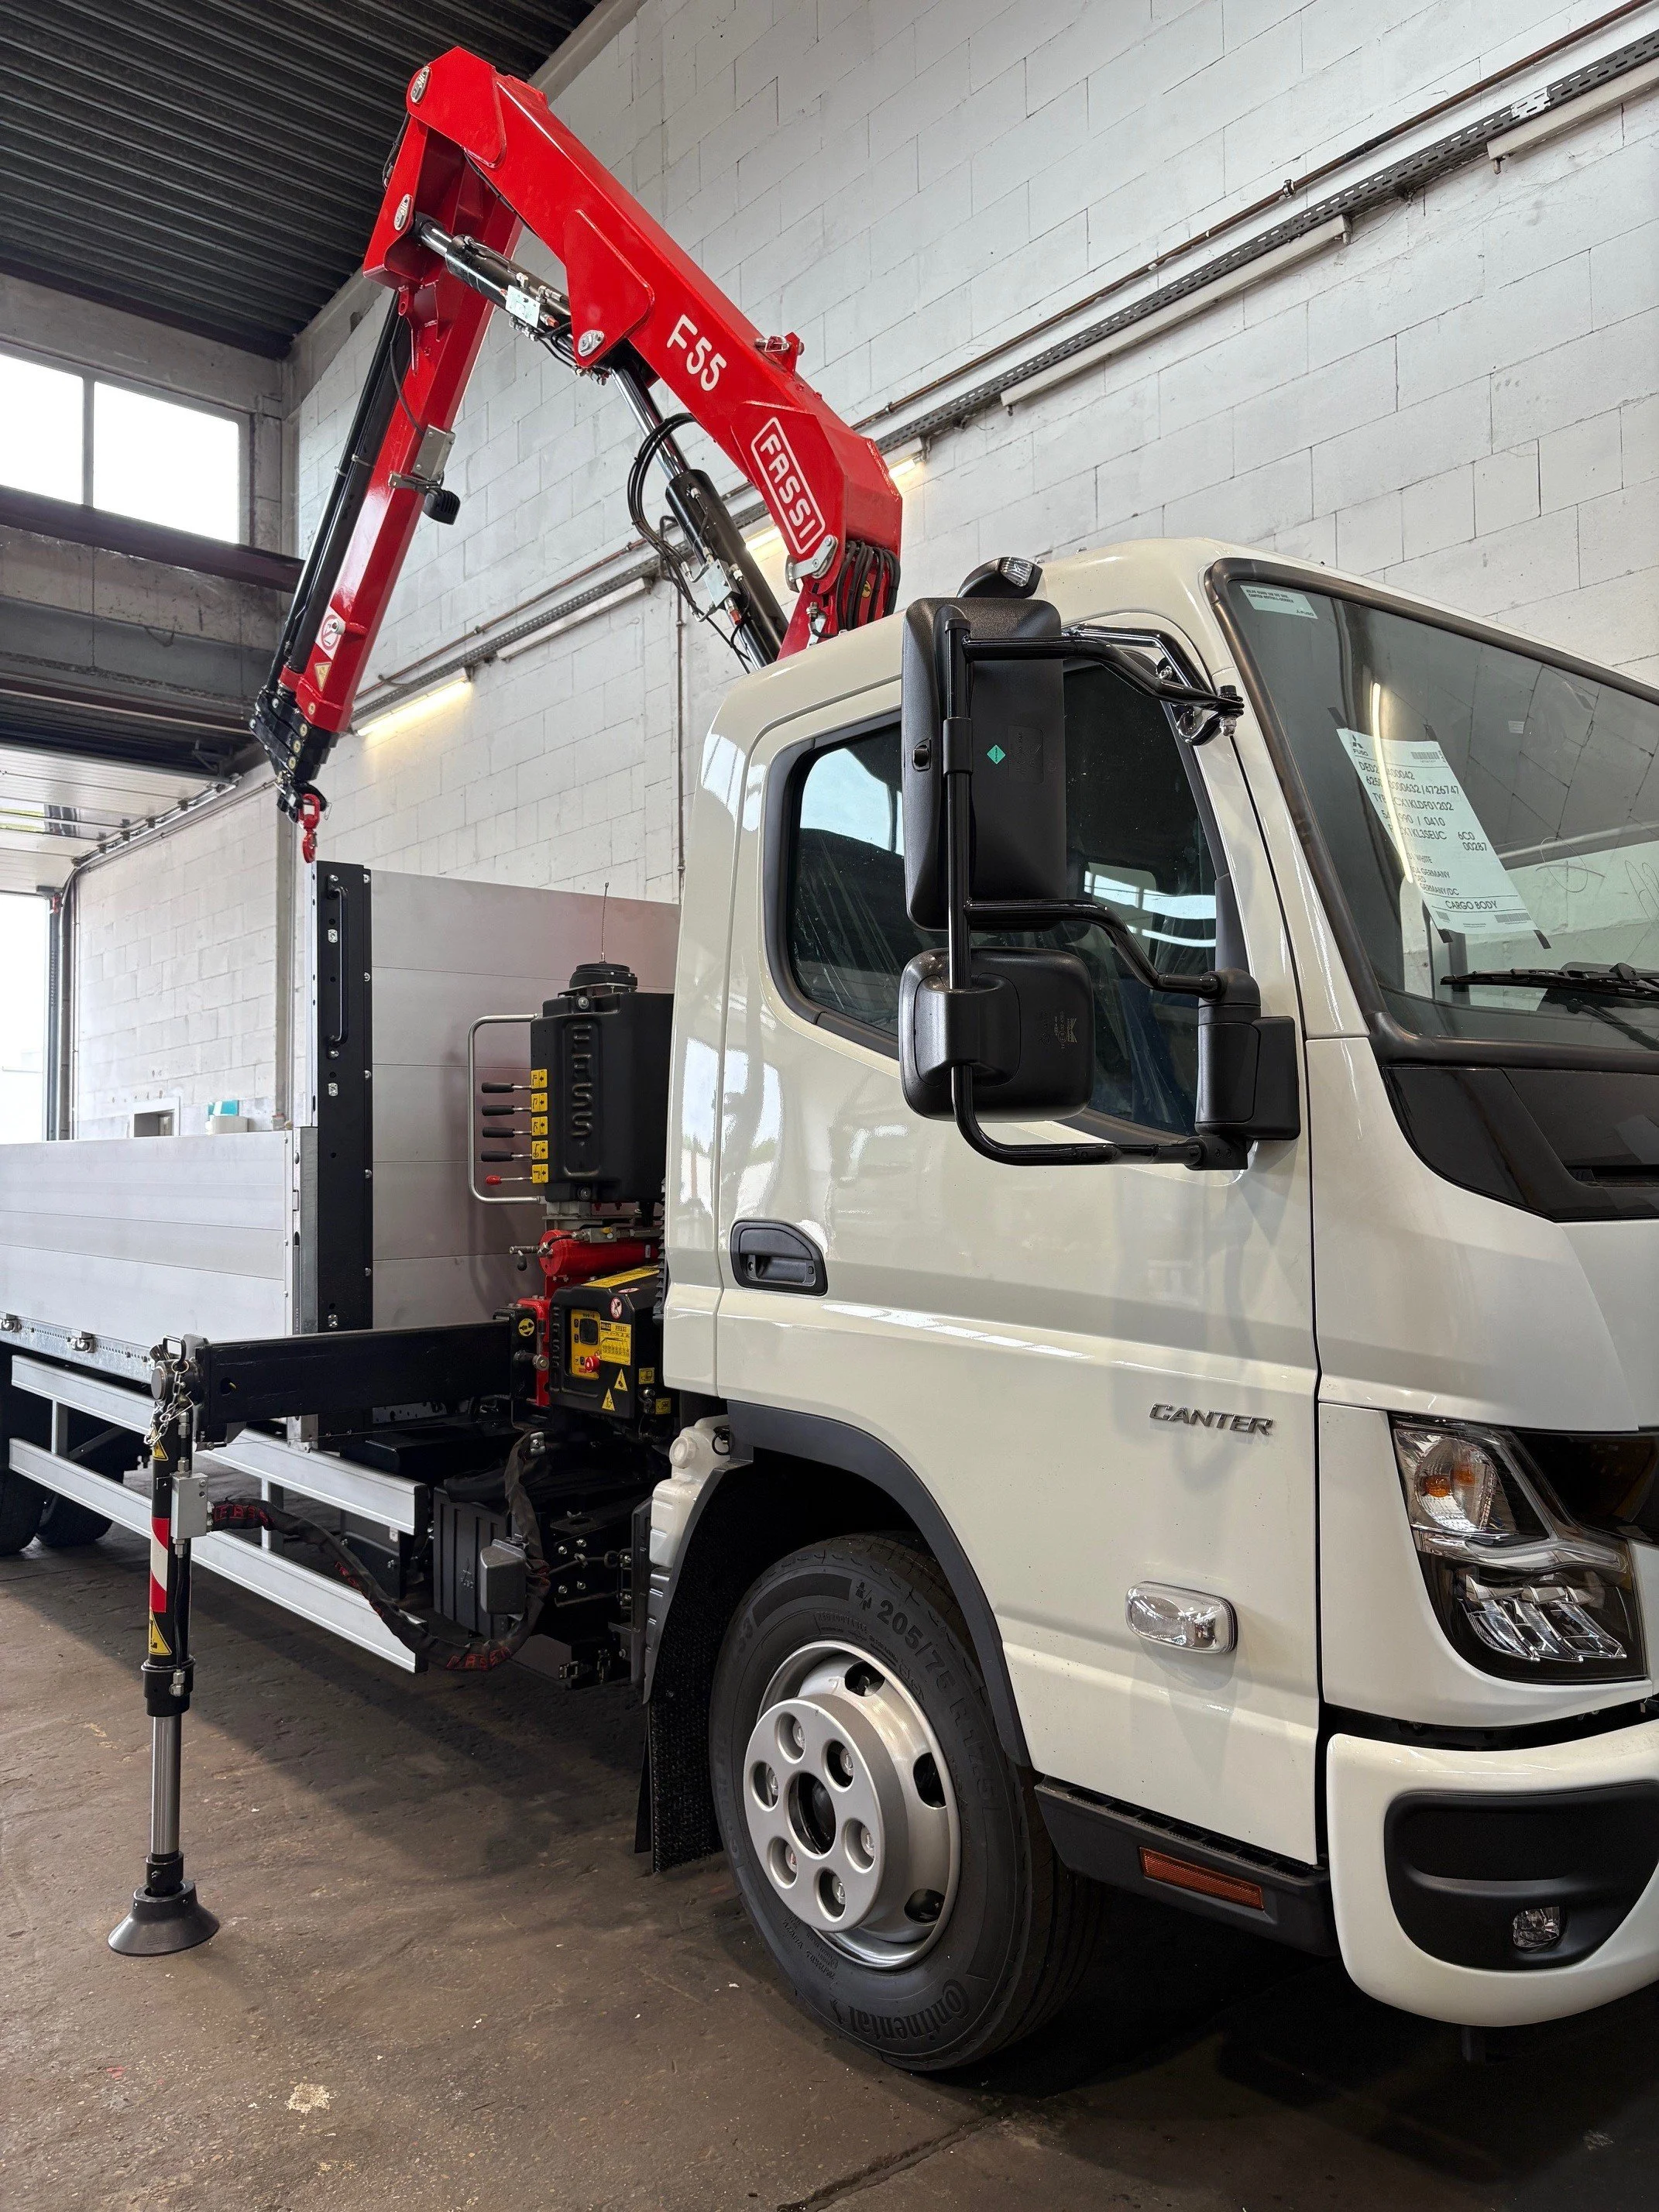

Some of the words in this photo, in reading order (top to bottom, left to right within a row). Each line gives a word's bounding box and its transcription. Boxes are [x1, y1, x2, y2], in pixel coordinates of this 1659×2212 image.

[667, 314, 727, 391] F55
[760, 433, 816, 540] FASSI
[1424, 816, 1445, 826] 0410
[1462, 842, 1487, 851] 00287
[1420, 867, 1451, 878] GERMANY
[1445, 901, 1474, 910] CARGO
[1475, 900, 1499, 910] BODY
[1149, 1403, 1273, 1436] CANTER
[847, 1978, 969, 2041] Continental
